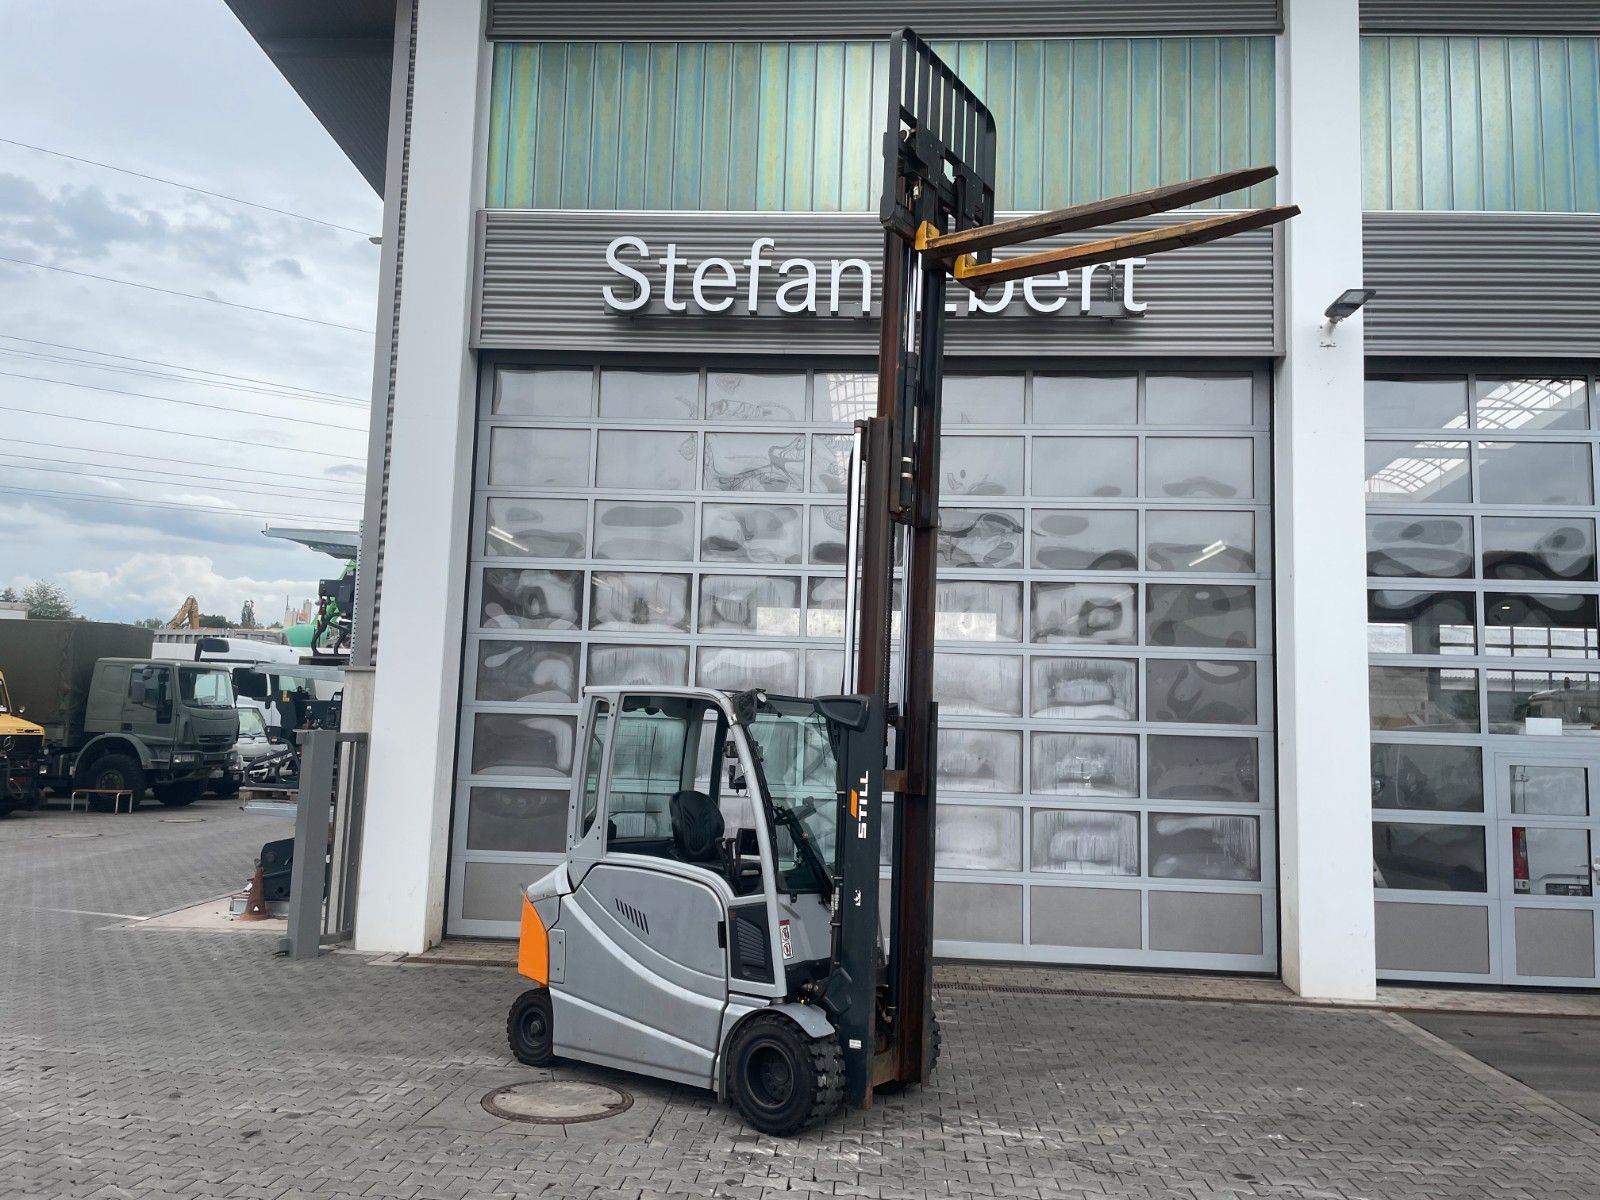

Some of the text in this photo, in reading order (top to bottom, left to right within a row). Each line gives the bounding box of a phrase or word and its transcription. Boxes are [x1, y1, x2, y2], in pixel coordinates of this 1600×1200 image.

[603, 236, 1147, 313] Stefan bert
[857, 770, 869, 839] STILL
